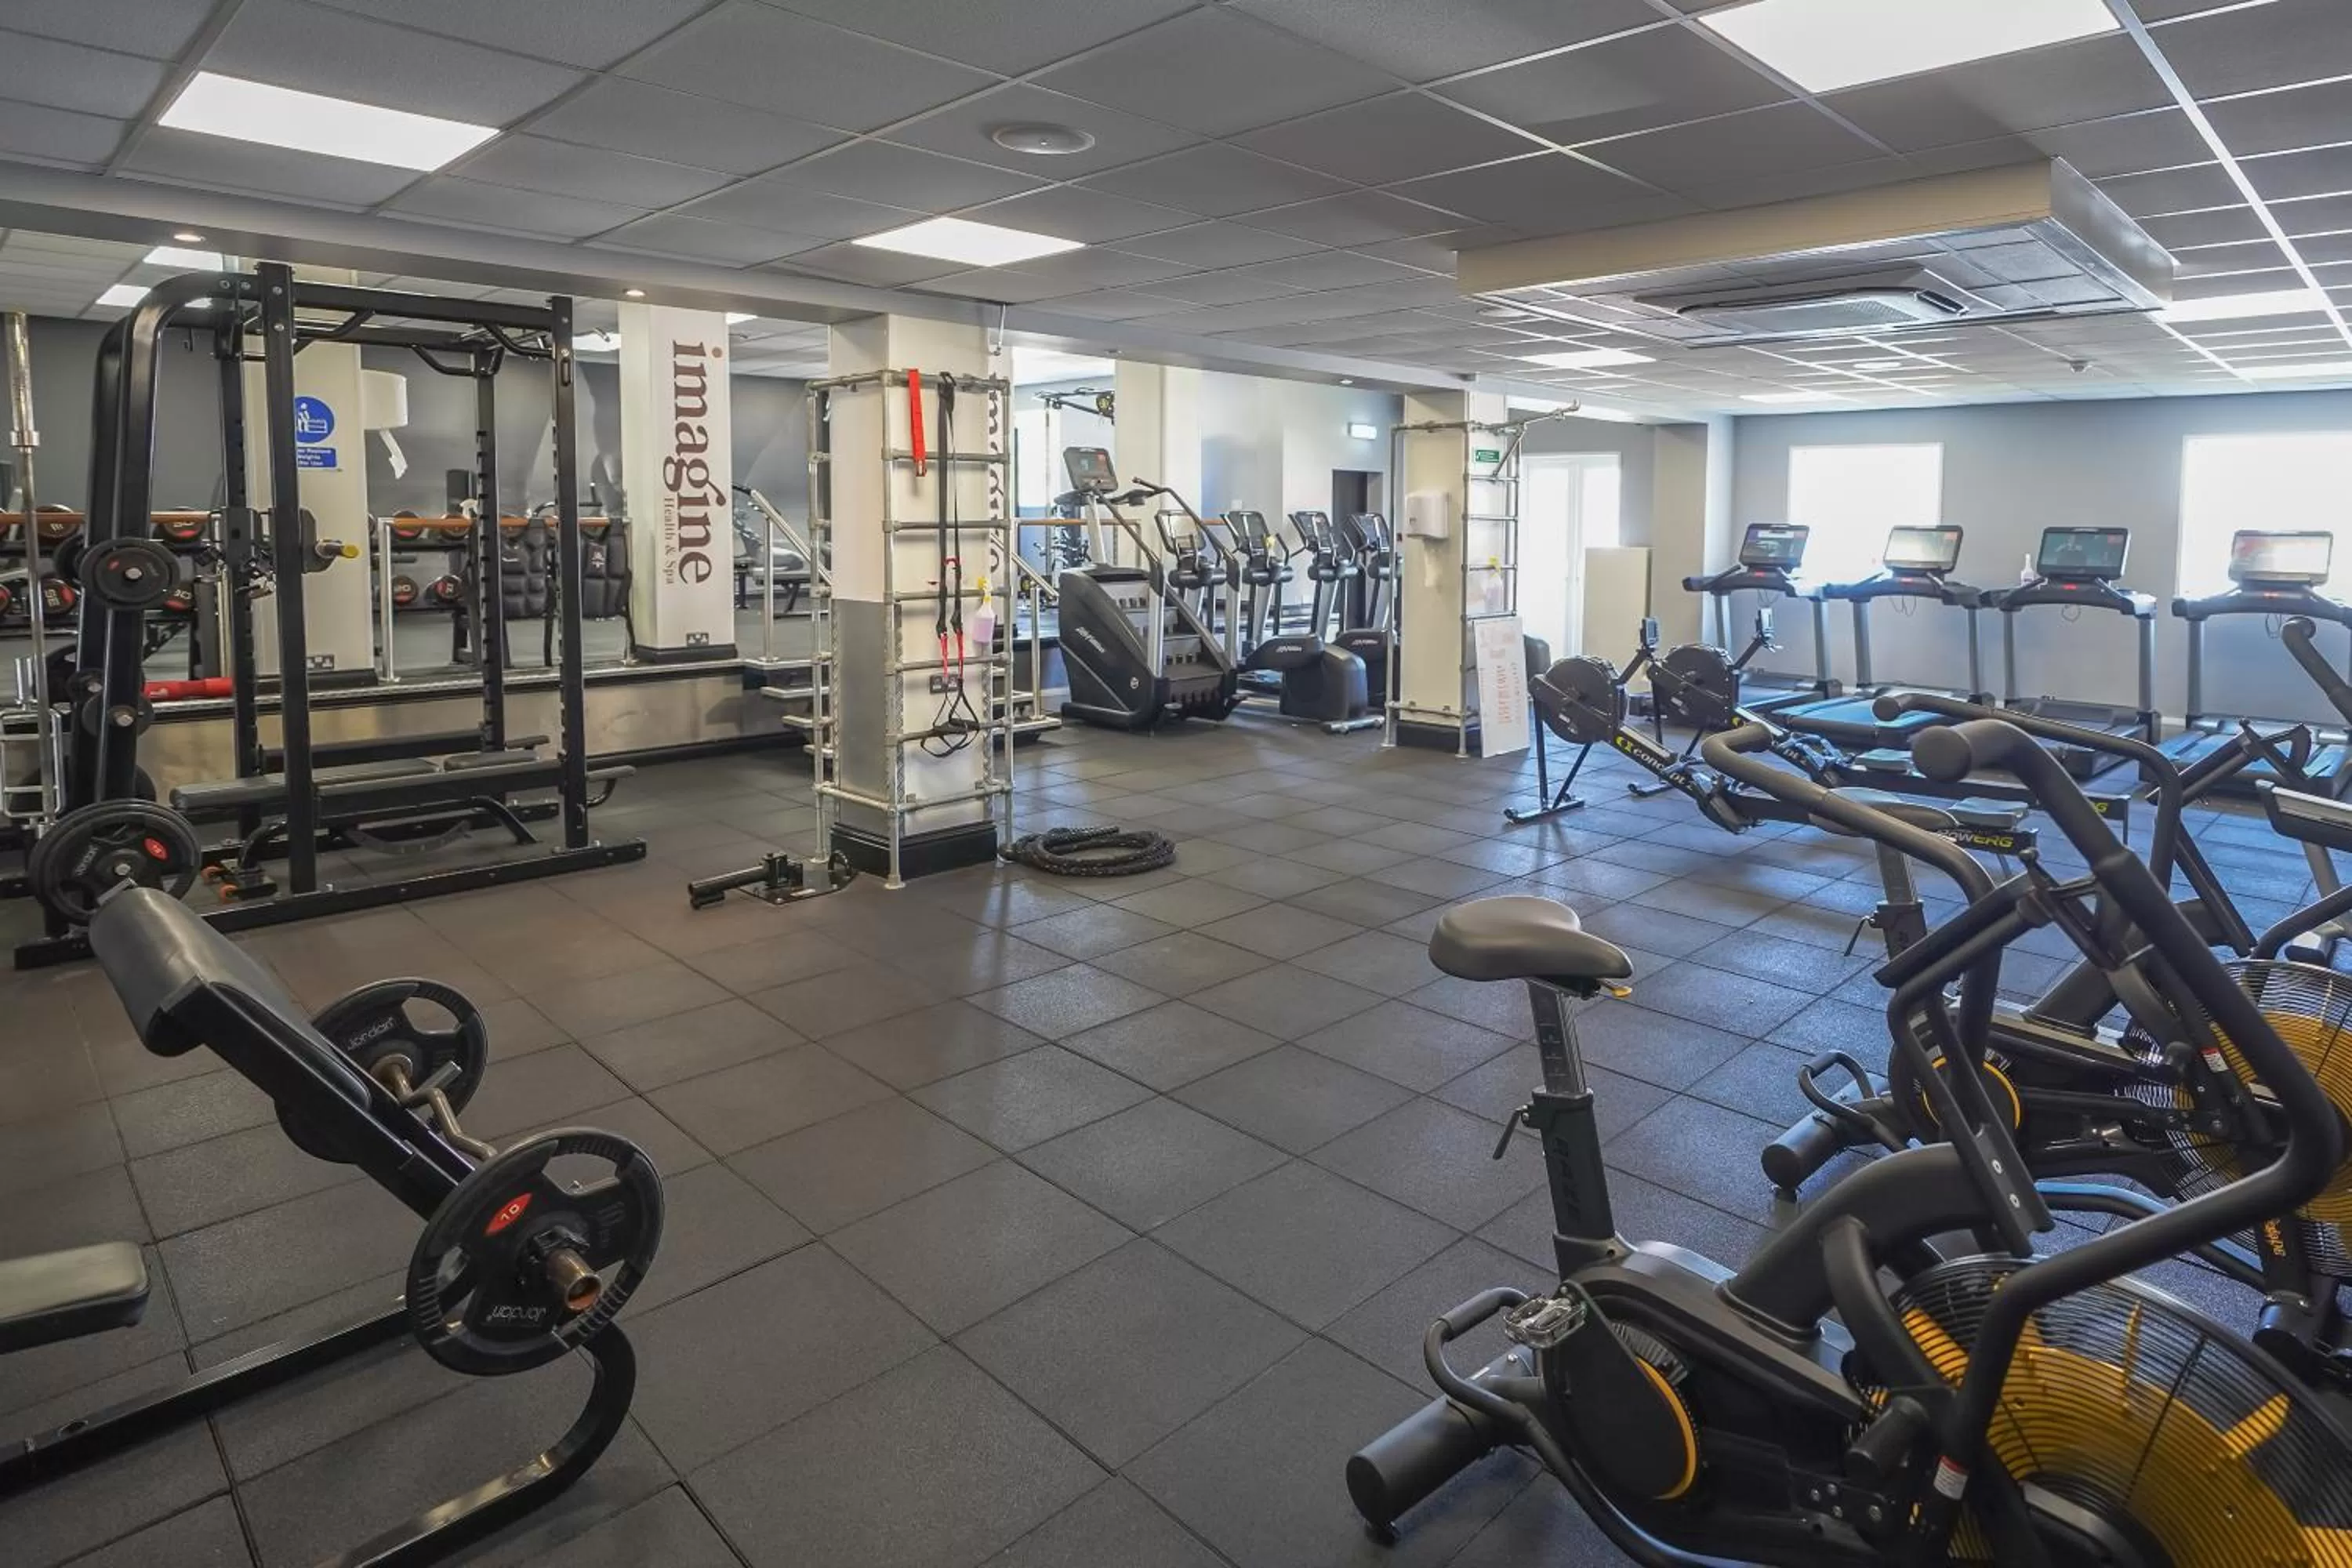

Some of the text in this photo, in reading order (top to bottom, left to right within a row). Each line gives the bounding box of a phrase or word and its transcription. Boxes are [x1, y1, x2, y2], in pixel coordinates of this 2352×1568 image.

[663, 339, 727, 585] imagine
[662, 497, 676, 585] Health & Spa
[1633, 747, 1687, 786] concpt
[499, 1203, 520, 1220] 10
